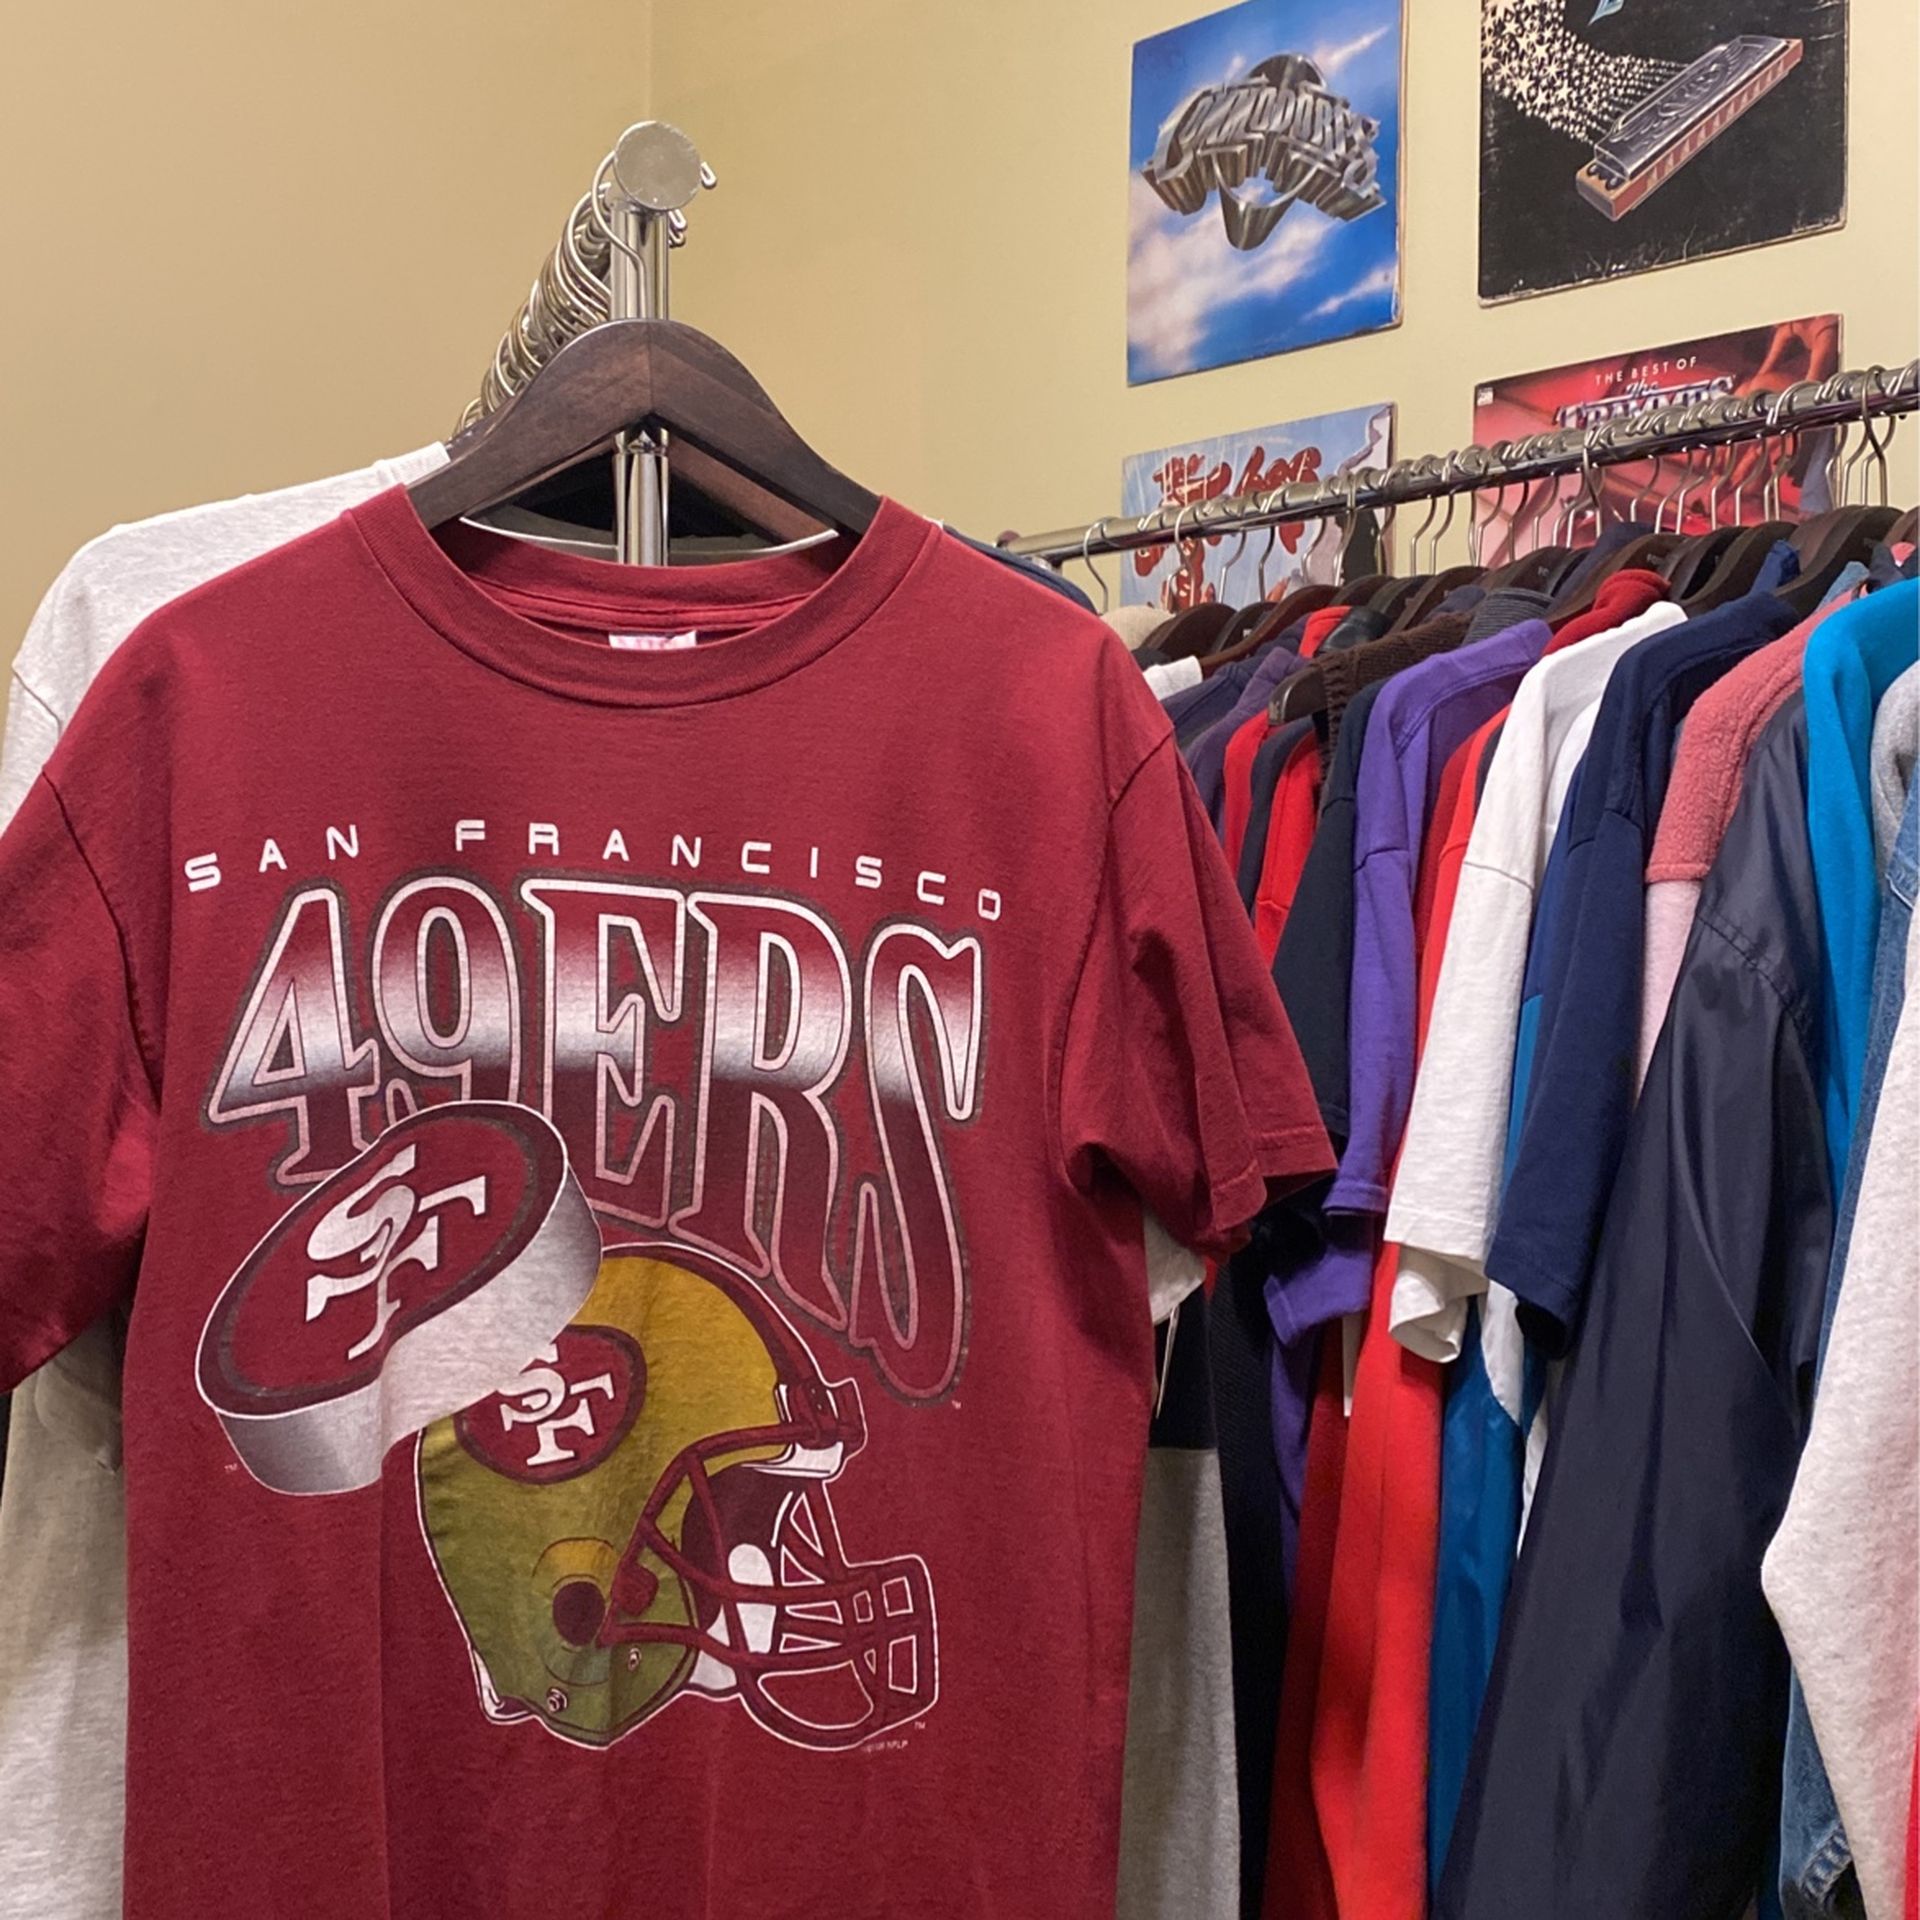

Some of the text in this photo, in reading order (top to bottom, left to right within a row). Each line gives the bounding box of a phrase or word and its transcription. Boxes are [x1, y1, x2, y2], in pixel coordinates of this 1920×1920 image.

[1595, 356, 1697, 386] THE BEST OF
[184, 819, 1002, 921] SAN FRANCISCO
[205, 872, 986, 1402] 49ERS
[306, 1143, 487, 1361] SF
